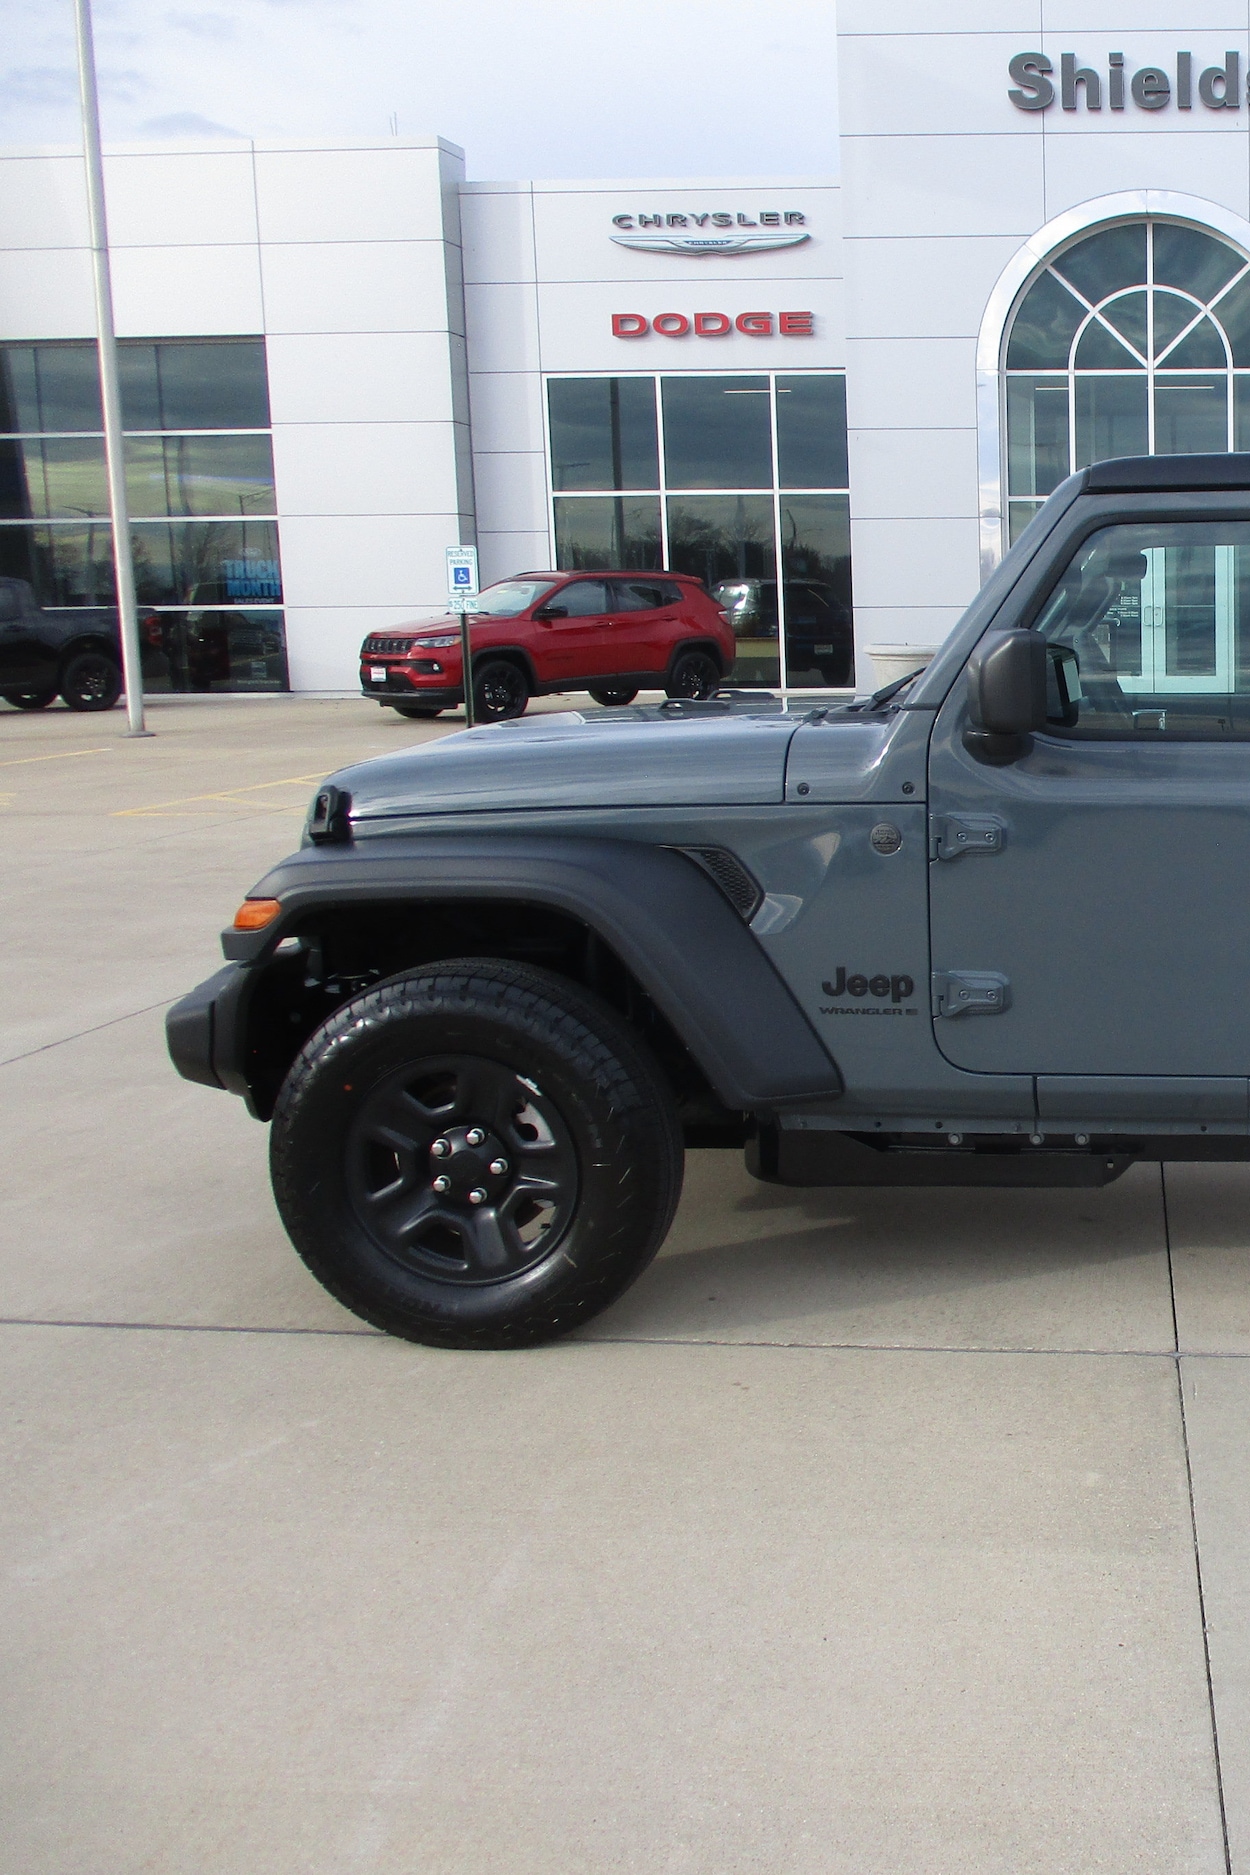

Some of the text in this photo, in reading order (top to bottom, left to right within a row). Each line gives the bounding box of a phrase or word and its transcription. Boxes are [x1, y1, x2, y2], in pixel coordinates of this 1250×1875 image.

[612, 211, 806, 228] CHRYSLER
[612, 312, 813, 337] DODGE
[224, 560, 279, 578] TRUCK
[227, 579, 281, 596] MONTH
[466, 600, 478, 609] FINE
[821, 966, 914, 1003] Jeep
[819, 1006, 903, 1016] WRANGLER
